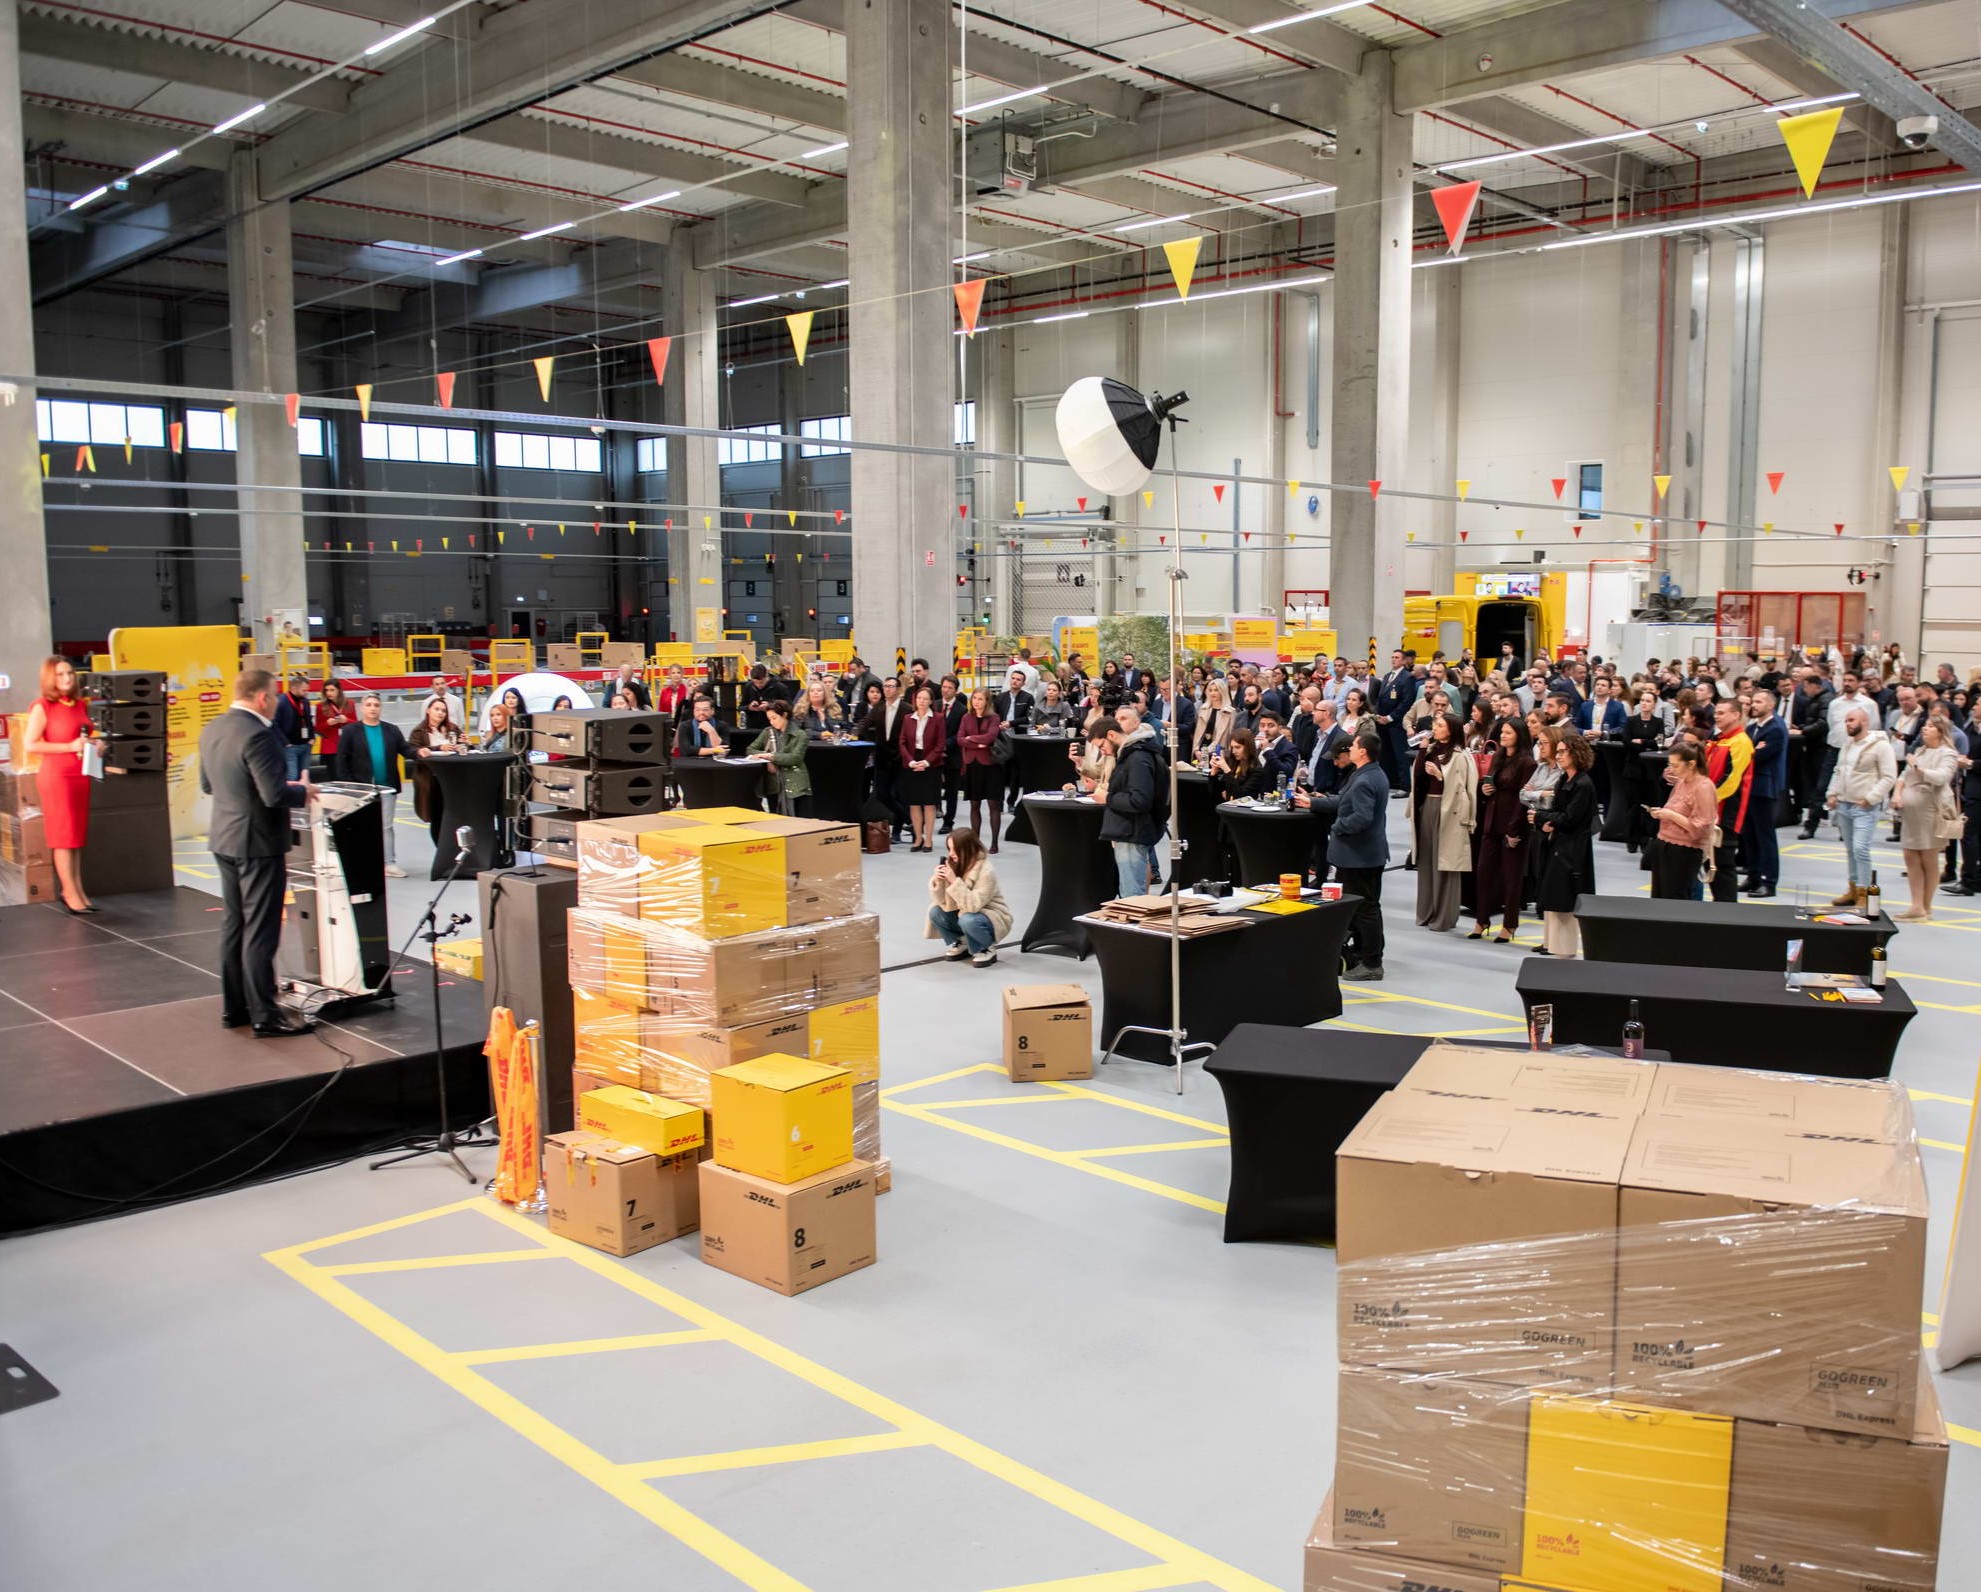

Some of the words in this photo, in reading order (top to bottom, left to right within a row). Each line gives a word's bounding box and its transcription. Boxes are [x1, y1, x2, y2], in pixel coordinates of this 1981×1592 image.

[823, 834, 851, 845] DHL
[744, 843, 773, 854] DHL
[708, 877, 720, 894] 7
[791, 871, 800, 887] 7
[1053, 1013, 1081, 1021] DHL
[771, 1024, 798, 1036] DHL
[813, 1039, 823, 1056] 7
[1018, 1035, 1028, 1050] 8
[821, 1082, 845, 1094] DHL
[1531, 1107, 1605, 1119] DHL
[586, 1118, 608, 1130] DHL
[670, 1134, 699, 1148] DHL
[790, 1125, 801, 1142] 6
[1801, 1133, 1881, 1145] DHL
[831, 1179, 864, 1197] DHL
[749, 1191, 777, 1208] DHL
[626, 1199, 637, 1217] 7
[794, 1228, 806, 1248] 8
[1521, 1330, 1586, 1347] GOGREEN
[1632, 1342, 1673, 1358] 100%
[1818, 1369, 1888, 1388] GOGREEN
[1344, 1508, 1371, 1520] 100%
[1457, 1525, 1500, 1540] GOGREEN
[1536, 1534, 1565, 1547] 100%
[1739, 1563, 1768, 1577] 100%
